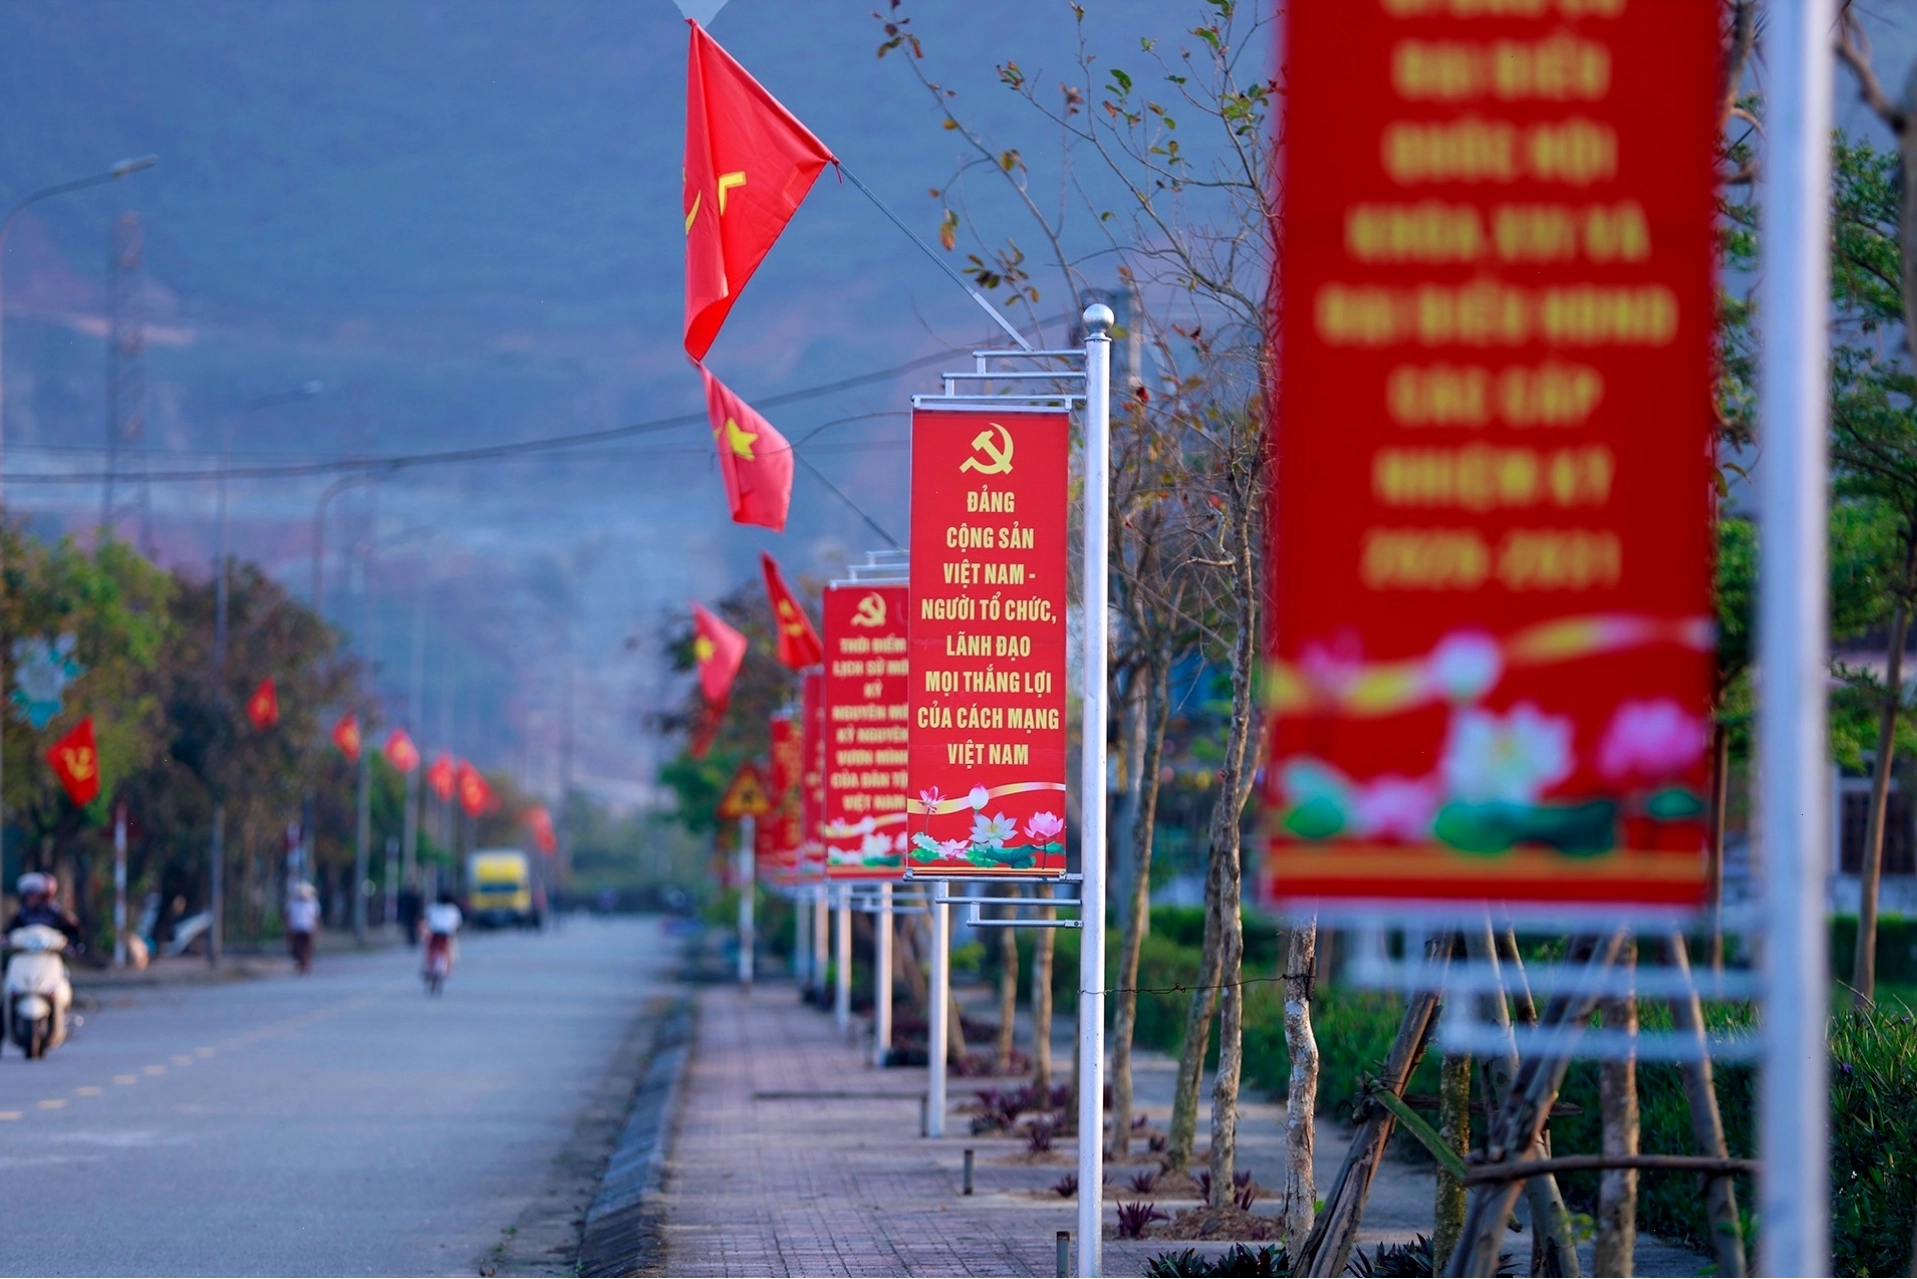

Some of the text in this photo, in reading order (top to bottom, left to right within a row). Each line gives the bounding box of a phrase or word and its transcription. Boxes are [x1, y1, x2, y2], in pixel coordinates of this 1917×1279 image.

[967, 484, 1015, 513] ĐẢNG
[946, 521, 1034, 553] CỘNG SẢN
[943, 559, 981, 588] VIỆT
[984, 563, 1025, 585] NAM
[921, 591, 1057, 624] NGƯỜI TỔ CHỨC,
[946, 631, 1031, 662] LÃNH ĐẠO
[925, 664, 1052, 698] MỌI THẮNG LỢI
[831, 702, 887, 721] NGUYÊN
[917, 700, 1060, 734] CỦA CÁCH MẠNG
[947, 739, 1029, 769] VIỆT NAM
[830, 768, 859, 789] CỦA
[861, 769, 890, 789] DÂN
[842, 792, 907, 814] VIỆT NAM
